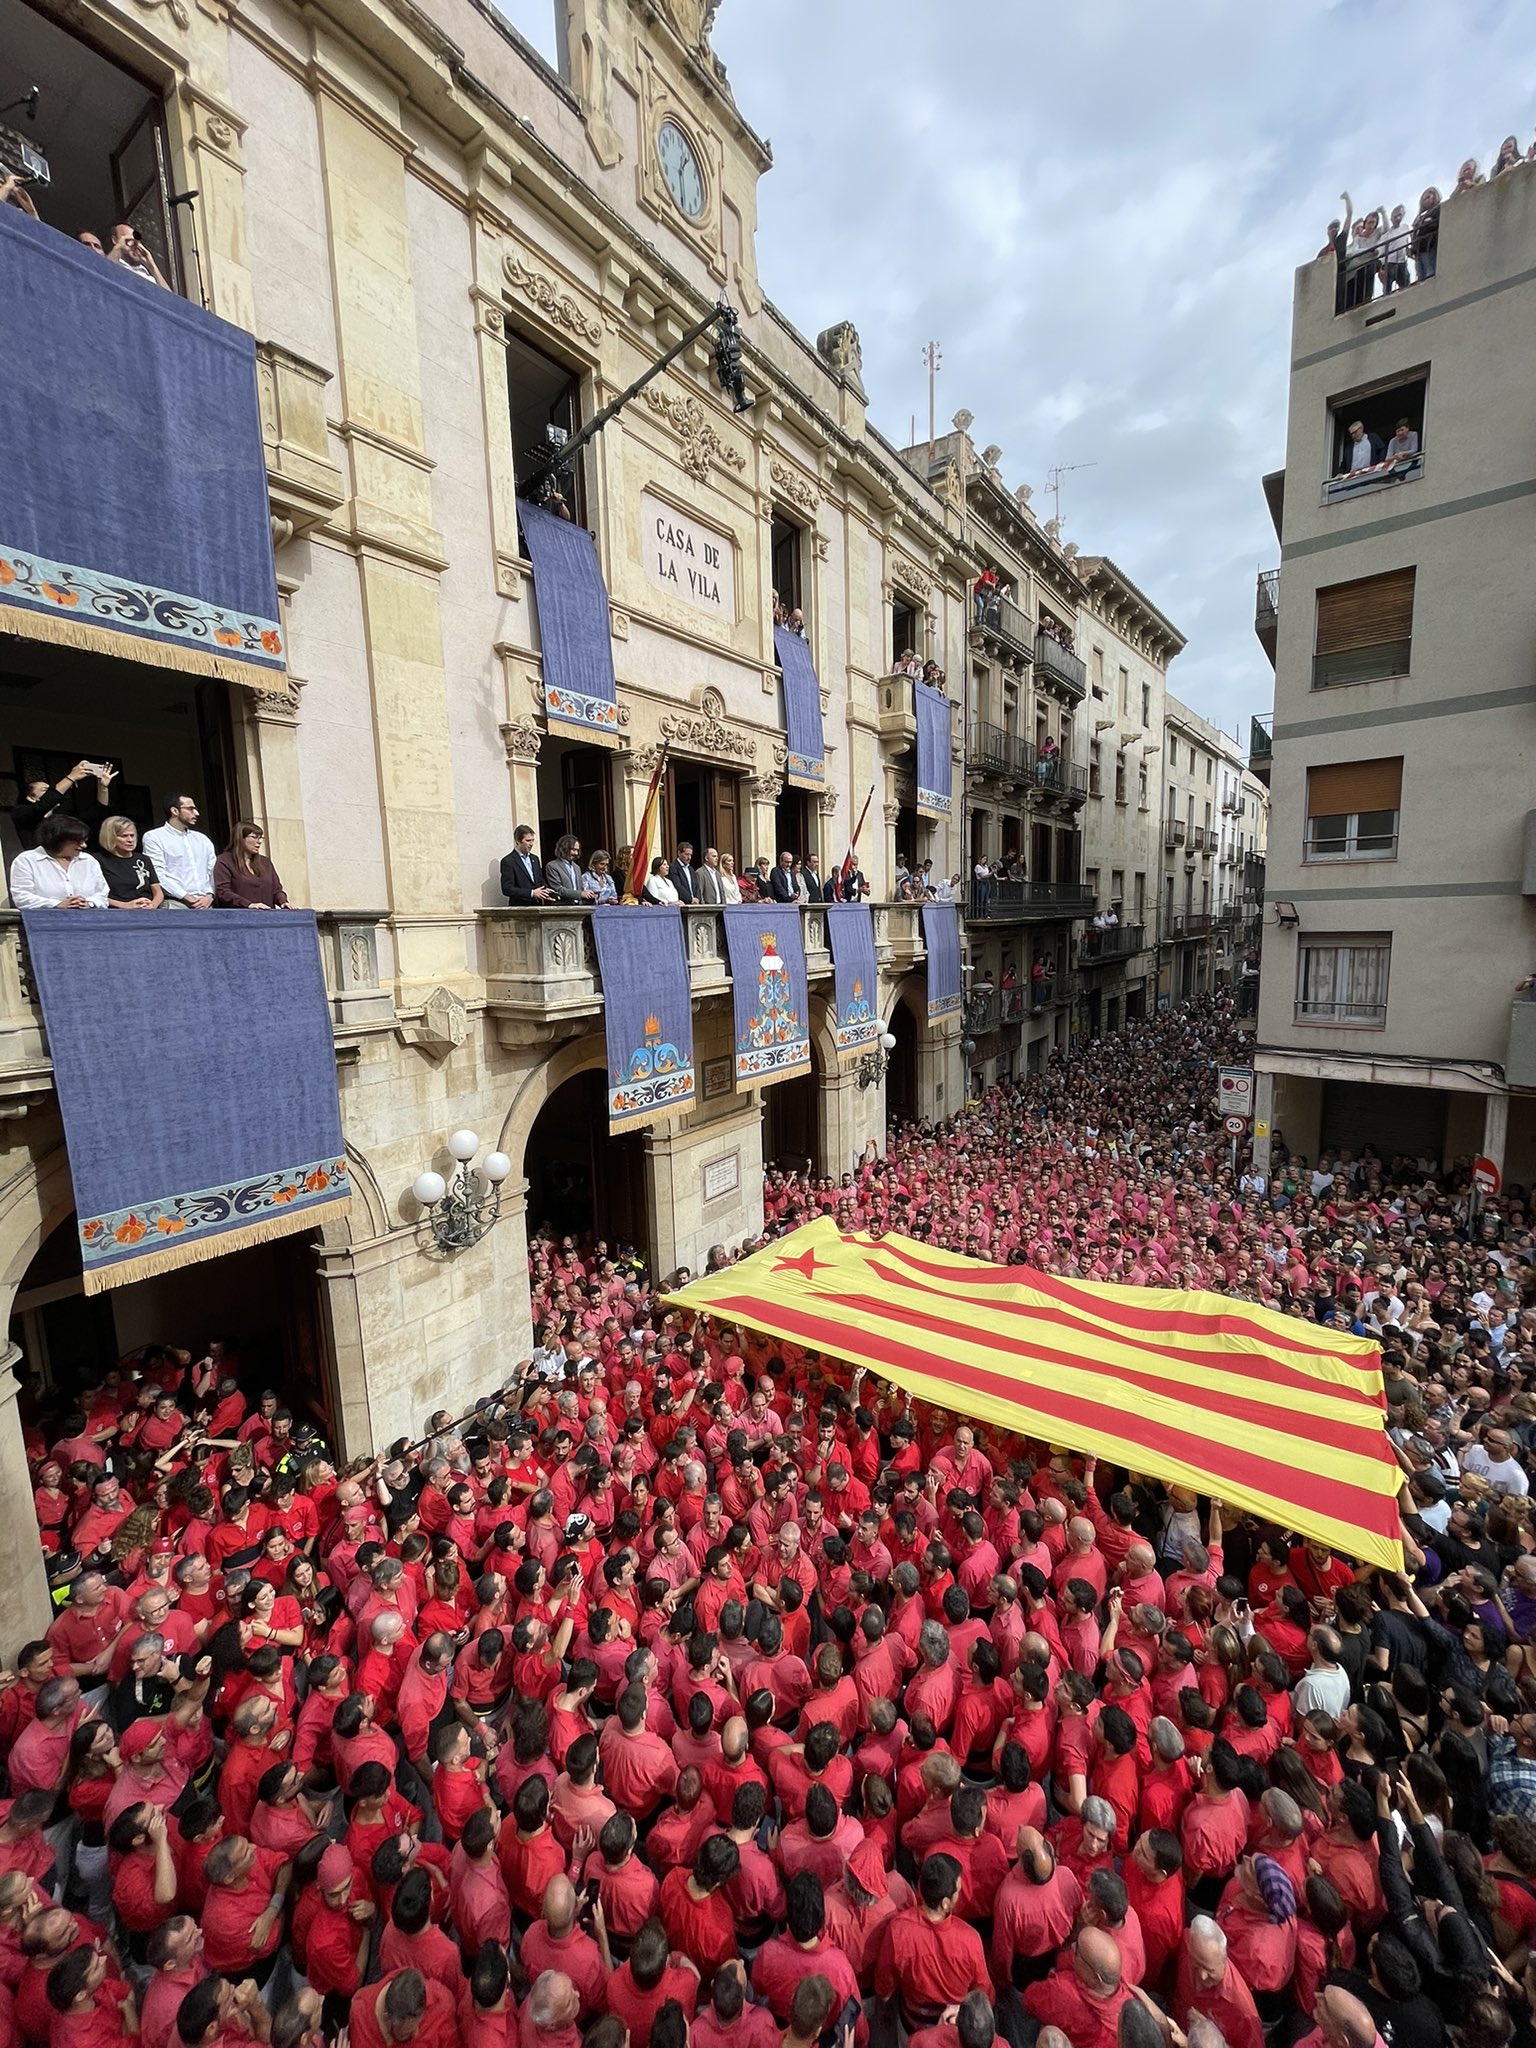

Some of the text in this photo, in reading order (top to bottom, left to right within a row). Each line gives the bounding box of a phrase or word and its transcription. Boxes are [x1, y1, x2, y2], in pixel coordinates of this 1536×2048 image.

[656, 517, 720, 570] CASA DE
[658, 552, 721, 604] LA VILA
[1228, 1121, 1241, 1129] 20
